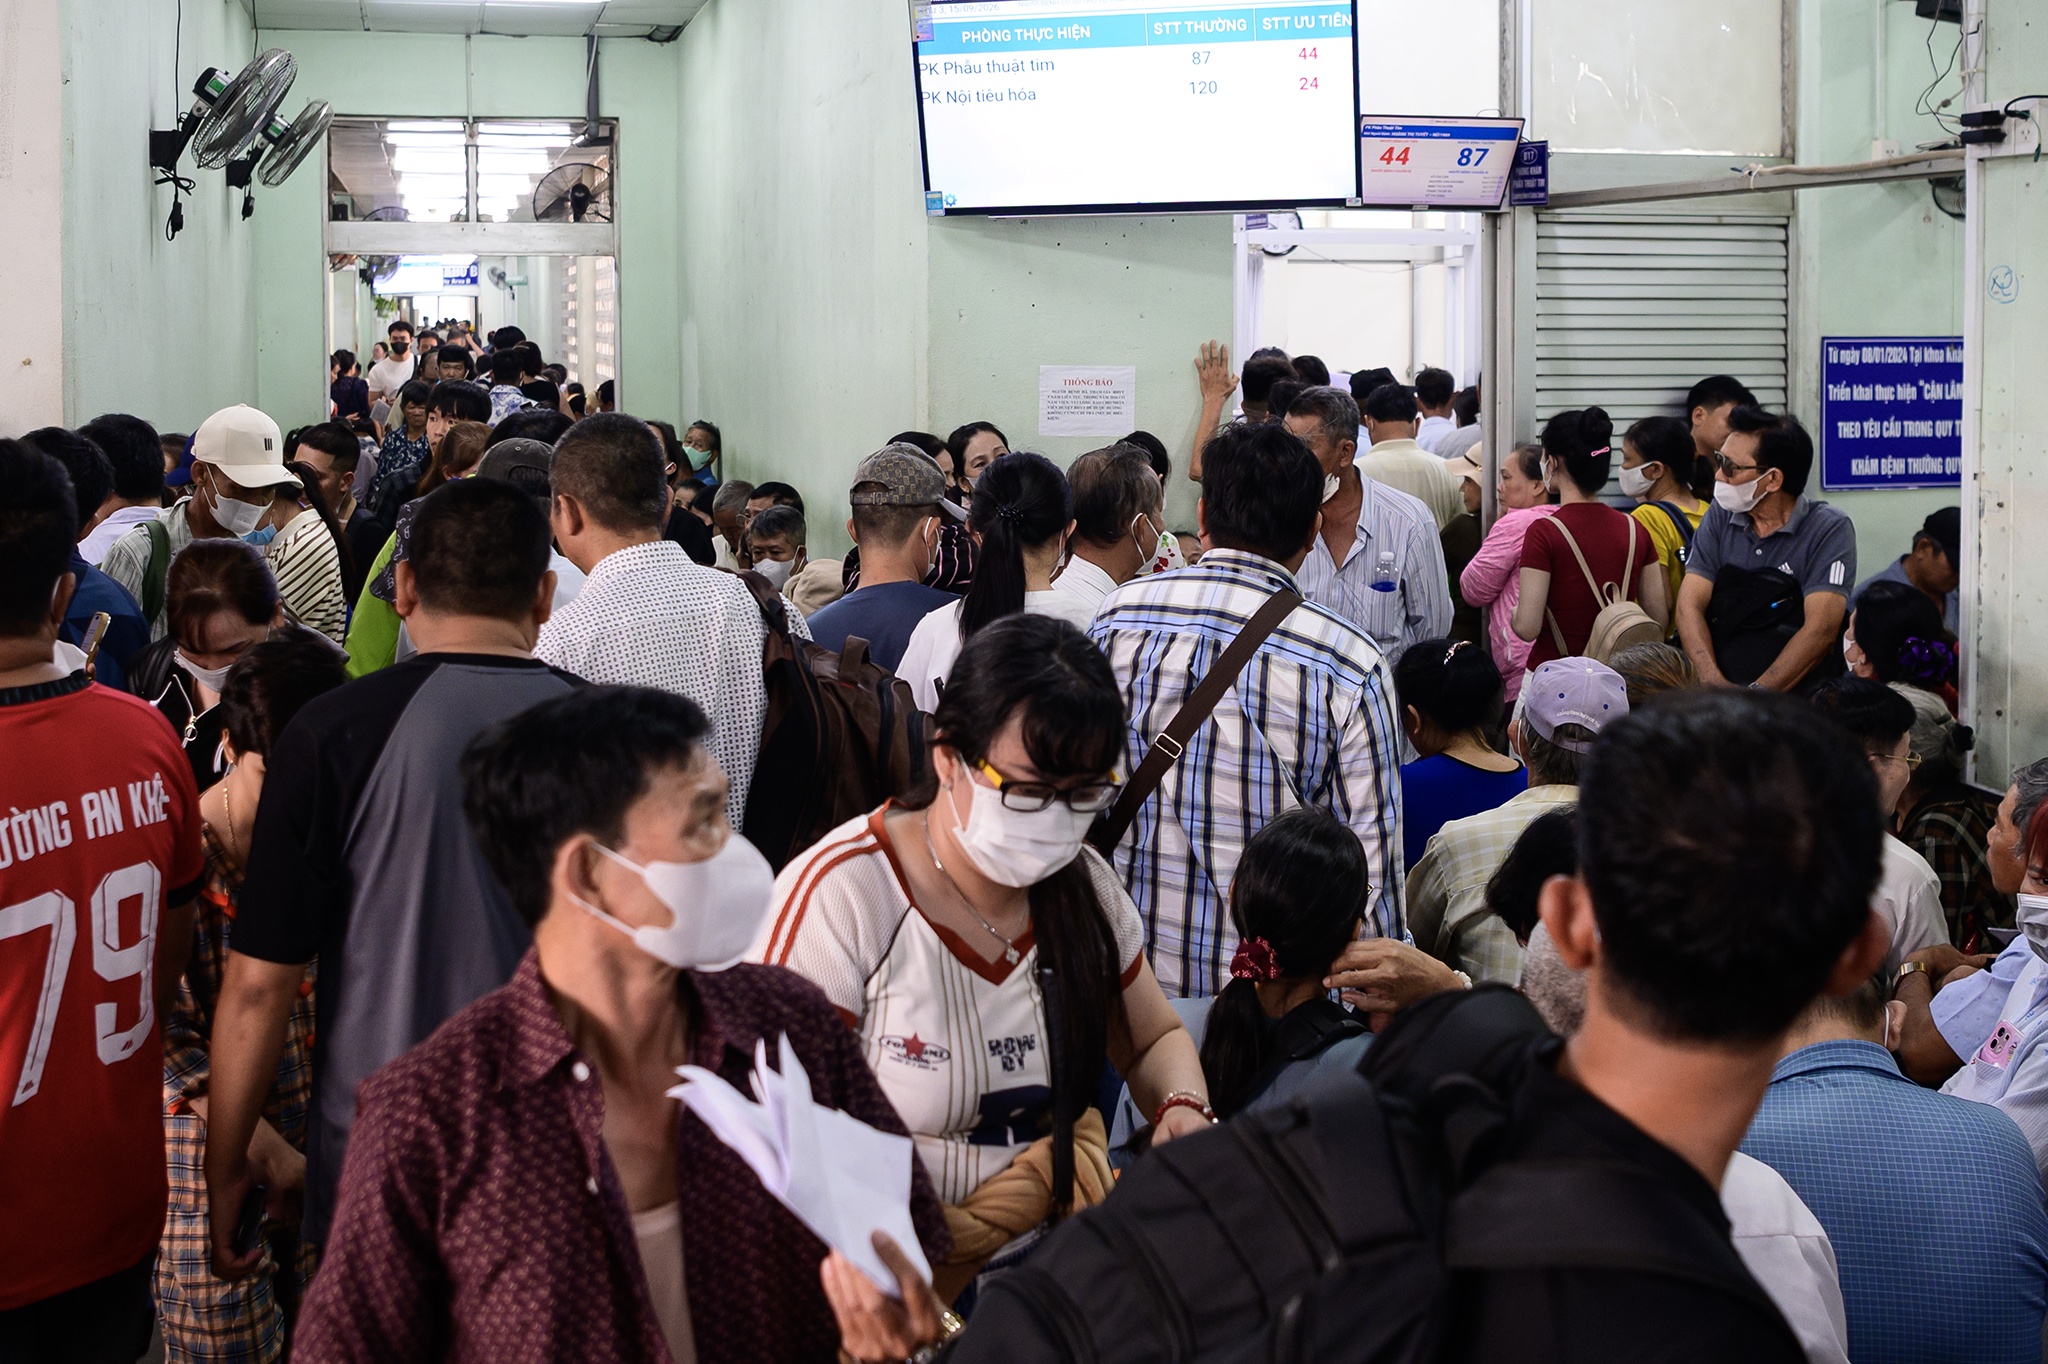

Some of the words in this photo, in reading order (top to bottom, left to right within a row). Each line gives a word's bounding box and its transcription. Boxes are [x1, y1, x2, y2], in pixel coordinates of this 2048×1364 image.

[950, 3, 1000, 13] 15/09/2026
[1154, 22, 1182, 36] STT
[1184, 16, 1248, 34] THƯỜNG
[1262, 16, 1291, 30] STT
[1294, 14, 1316, 28] ƯU
[1319, 12, 1352, 27] TIÊN
[962, 28, 1012, 43] PHÒNG
[1014, 26, 1054, 42] THỰC
[1057, 24, 1090, 41] HIỆN
[1192, 51, 1211, 65] 87
[1298, 46, 1318, 60] 44
[920, 62, 939, 76] PK
[944, 59, 982, 75] Phẫu
[986, 58, 1026, 76] thuật
[1030, 58, 1055, 72] tim
[1188, 80, 1218, 94] 120
[1299, 76, 1319, 90] 24
[922, 91, 942, 104] PK
[946, 89, 972, 106] Nội
[976, 88, 1004, 102] tiêu
[1008, 88, 1036, 102] hóa
[1379, 146, 1410, 166] 44
[1457, 148, 1490, 166] 87
[470, 264, 478, 278] B
[1828, 346, 1838, 364] Từ
[1840, 346, 1860, 366] ngày
[1862, 346, 1908, 364] 08/01/2024
[1910, 346, 1922, 366] Tại
[1924, 346, 1944, 363] khoa
[1062, 377, 1093, 386] THÔNG
[1095, 378, 1113, 386] BÁO
[1852, 384, 1873, 400] khai
[1874, 384, 1895, 404] thực
[1896, 382, 1917, 404] hiện
[1838, 421, 1861, 438] THEO
[1863, 418, 1880, 438] YÊU
[1904, 420, 1933, 438] TRONG
[1935, 420, 1953, 438] QUY
[1955, 420, 1962, 437] T
[1852, 456, 1878, 476] KHÁM
[1880, 455, 1906, 478] BỆNH
[1907, 454, 1942, 474] THƯỜNG
[81, 786, 124, 840] AN
[128, 772, 170, 828] KHÊ
[0, 859, 162, 1108] 79
